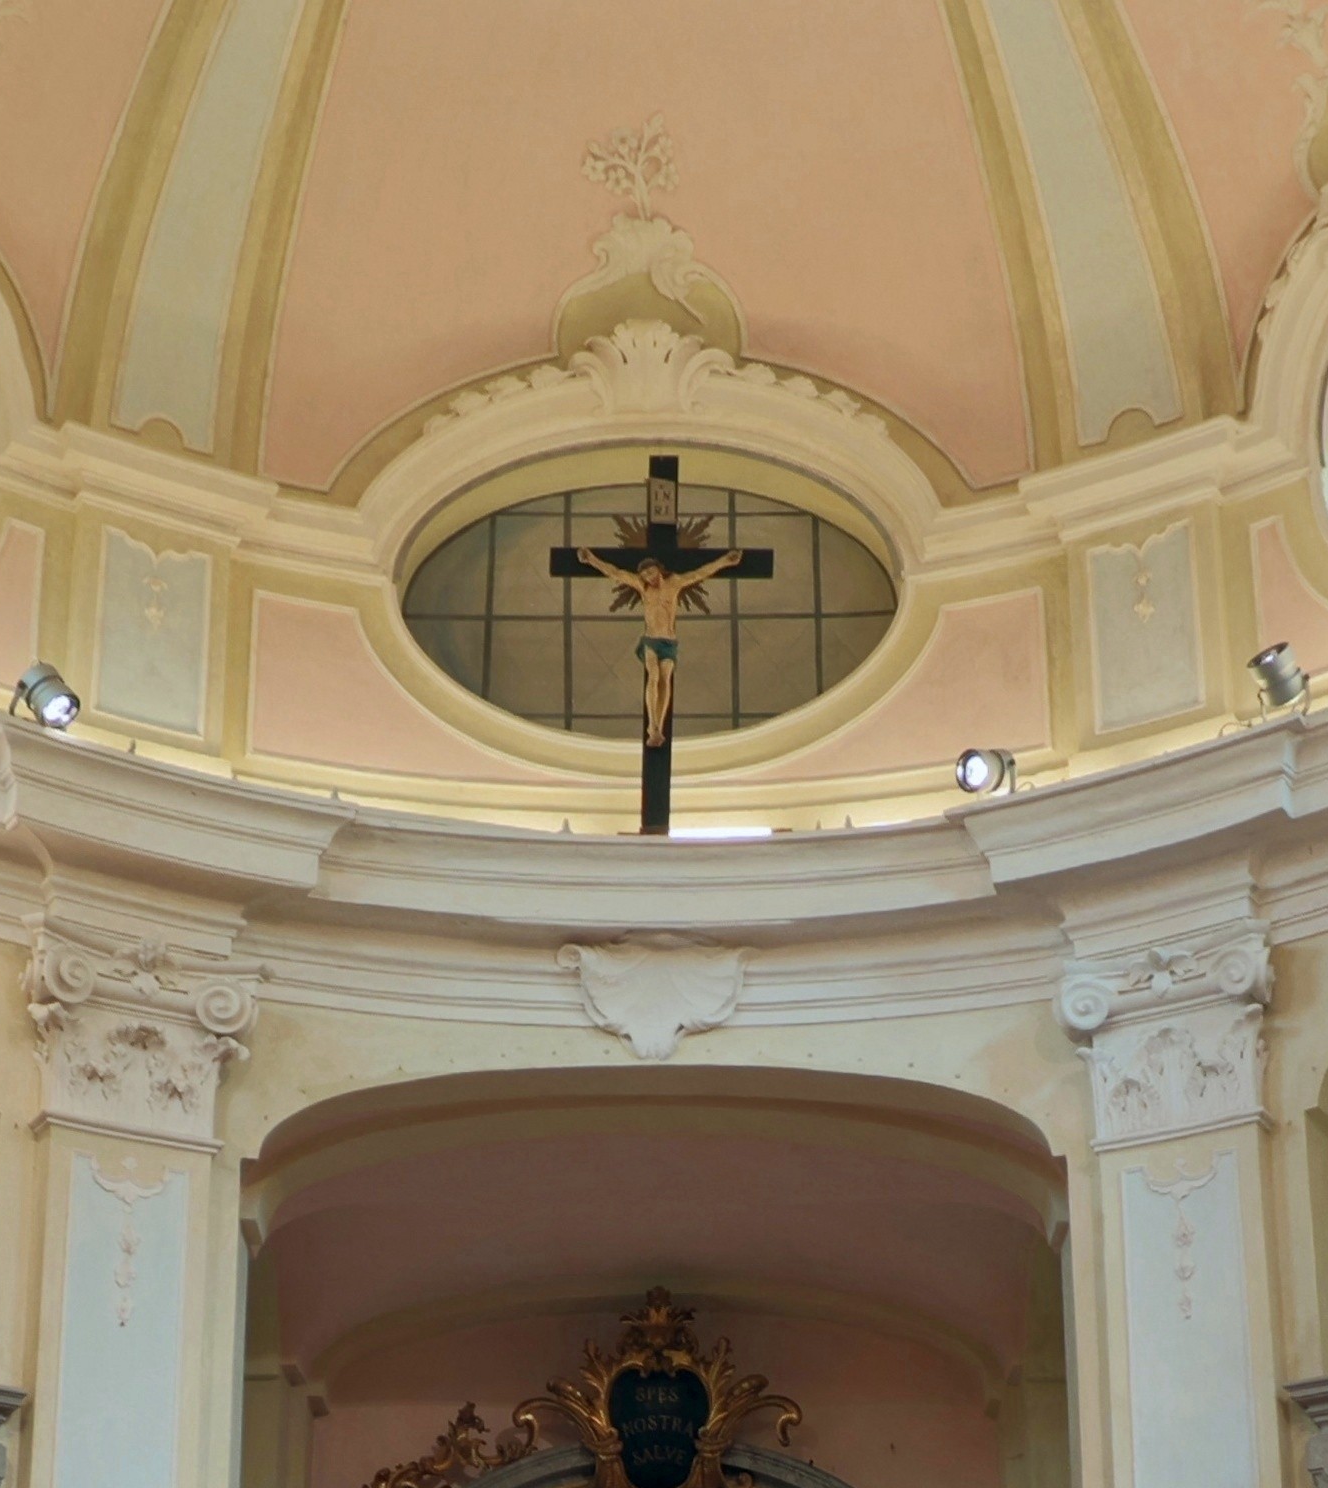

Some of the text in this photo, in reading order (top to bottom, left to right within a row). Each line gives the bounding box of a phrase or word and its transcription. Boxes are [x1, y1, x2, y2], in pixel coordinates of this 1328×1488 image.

[635, 1386, 680, 1404] SPES
[622, 1414, 694, 1438] NOSTRA
[632, 1444, 687, 1466] SALVE
